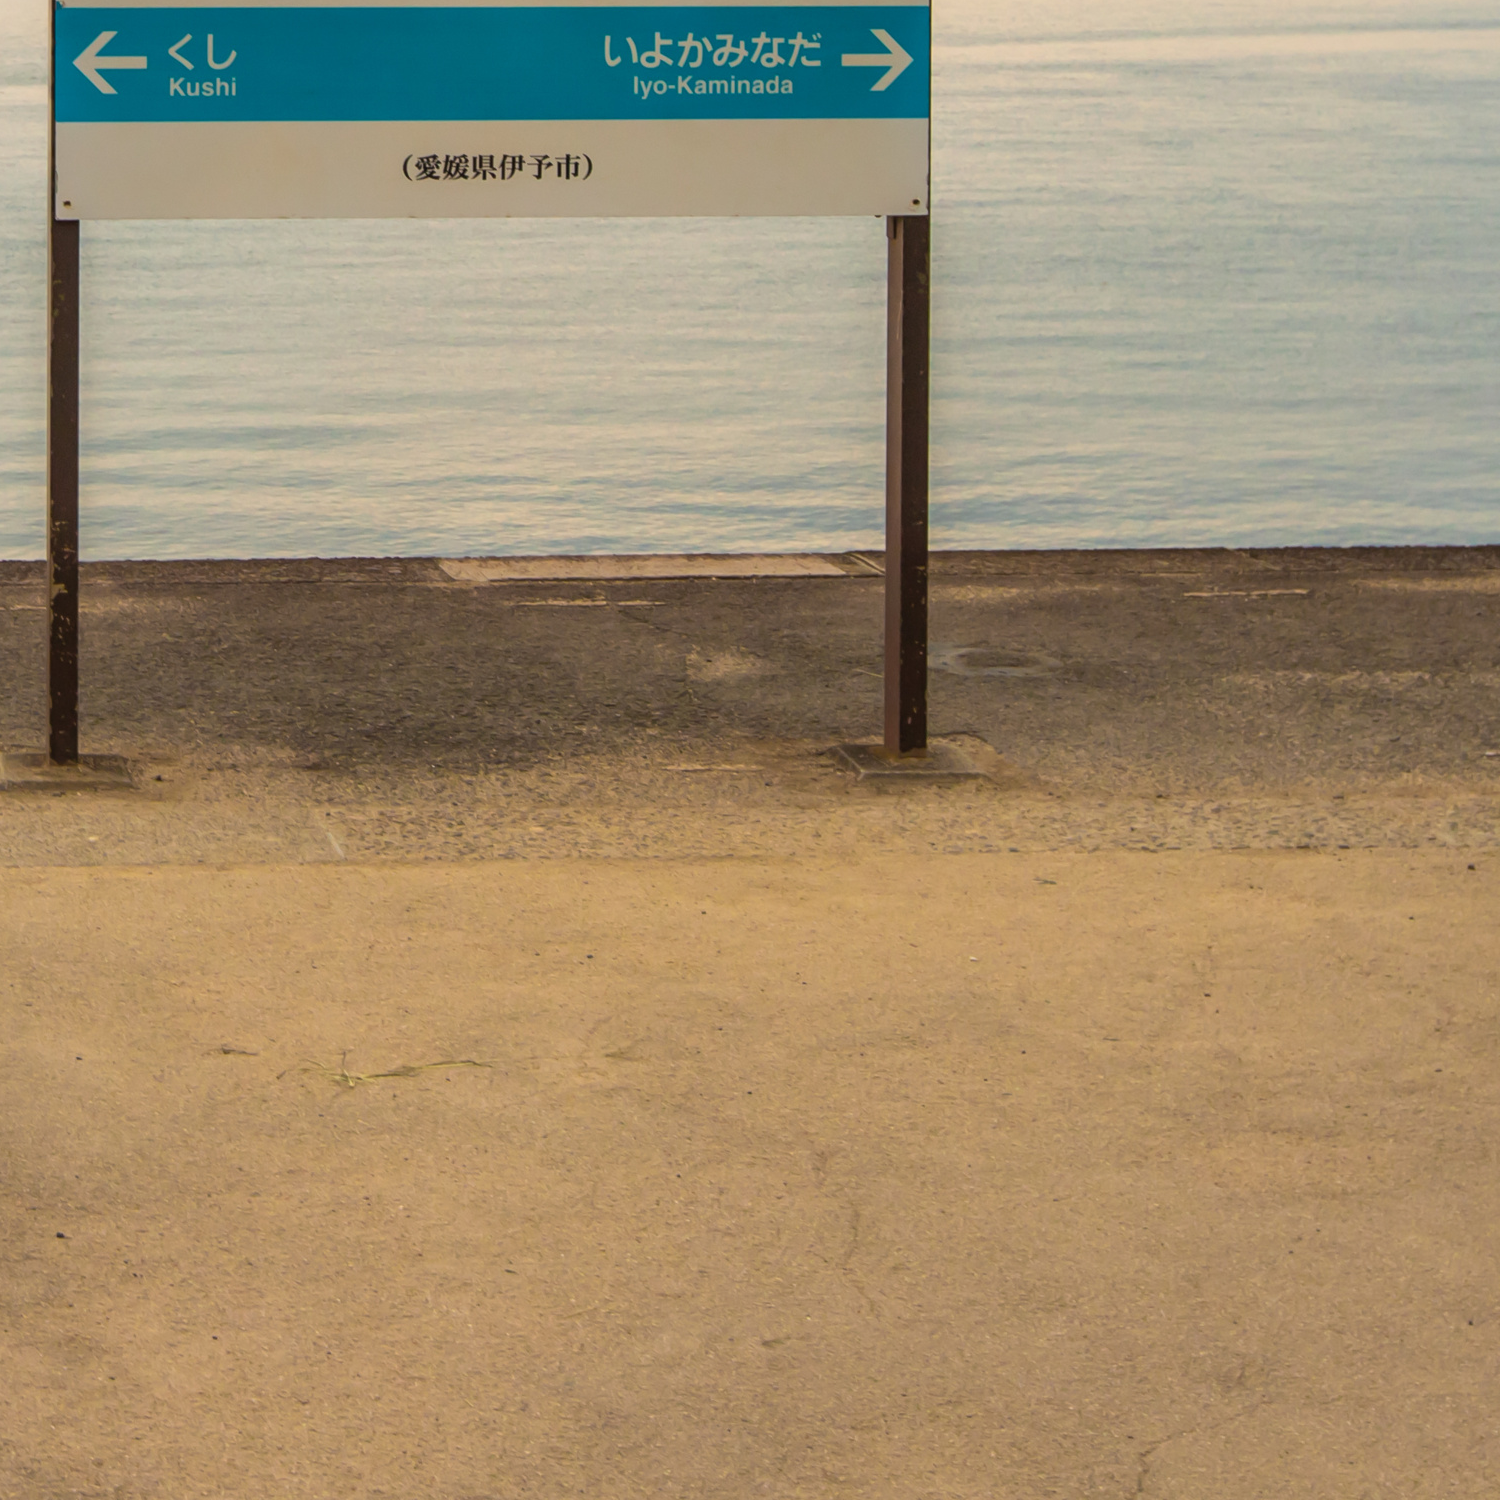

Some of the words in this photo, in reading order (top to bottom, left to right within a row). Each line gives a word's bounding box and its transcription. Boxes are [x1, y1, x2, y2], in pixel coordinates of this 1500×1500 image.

[167, 32, 238, 71] くし
[603, 31, 823, 70] いよかみなだ
[168, 76, 237, 97] Kushi
[632, 74, 794, 100] Iyo-Kaminada
